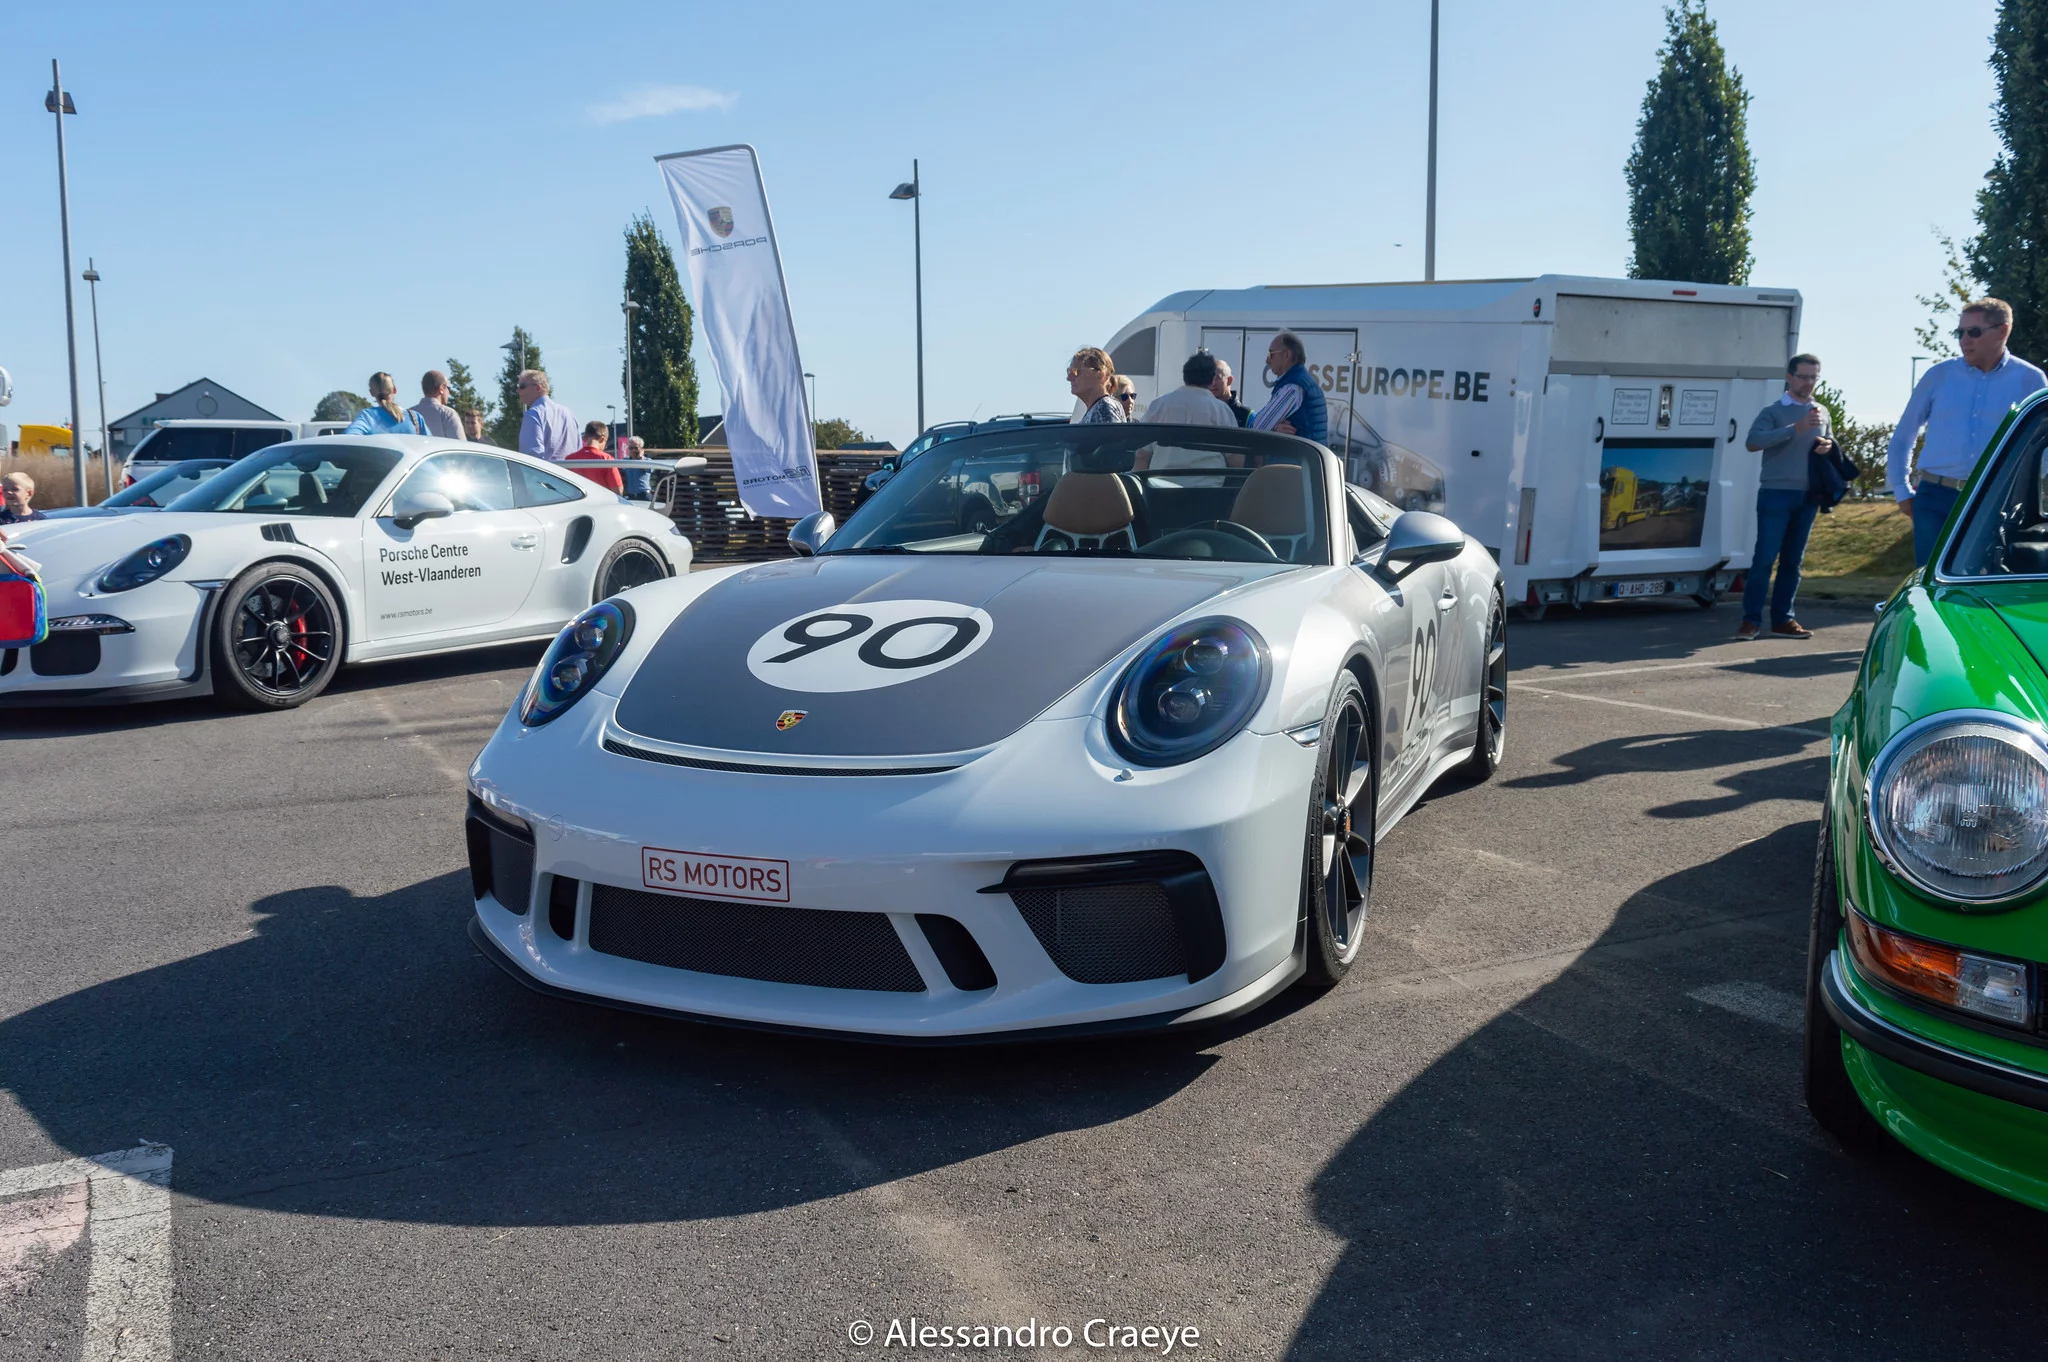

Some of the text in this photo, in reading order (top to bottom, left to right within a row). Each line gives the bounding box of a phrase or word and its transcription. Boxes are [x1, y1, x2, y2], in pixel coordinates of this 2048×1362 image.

[1262, 362, 1491, 402] CSSEUROPE.BE
[379, 544, 469, 562] Porsche Centre
[381, 565, 482, 586] West-Vlaanderen
[380, 607, 433, 620] www.rsmotors.be
[762, 612, 981, 670] 90
[1406, 619, 1436, 731] 90
[648, 856, 782, 893] RS MOTORS
